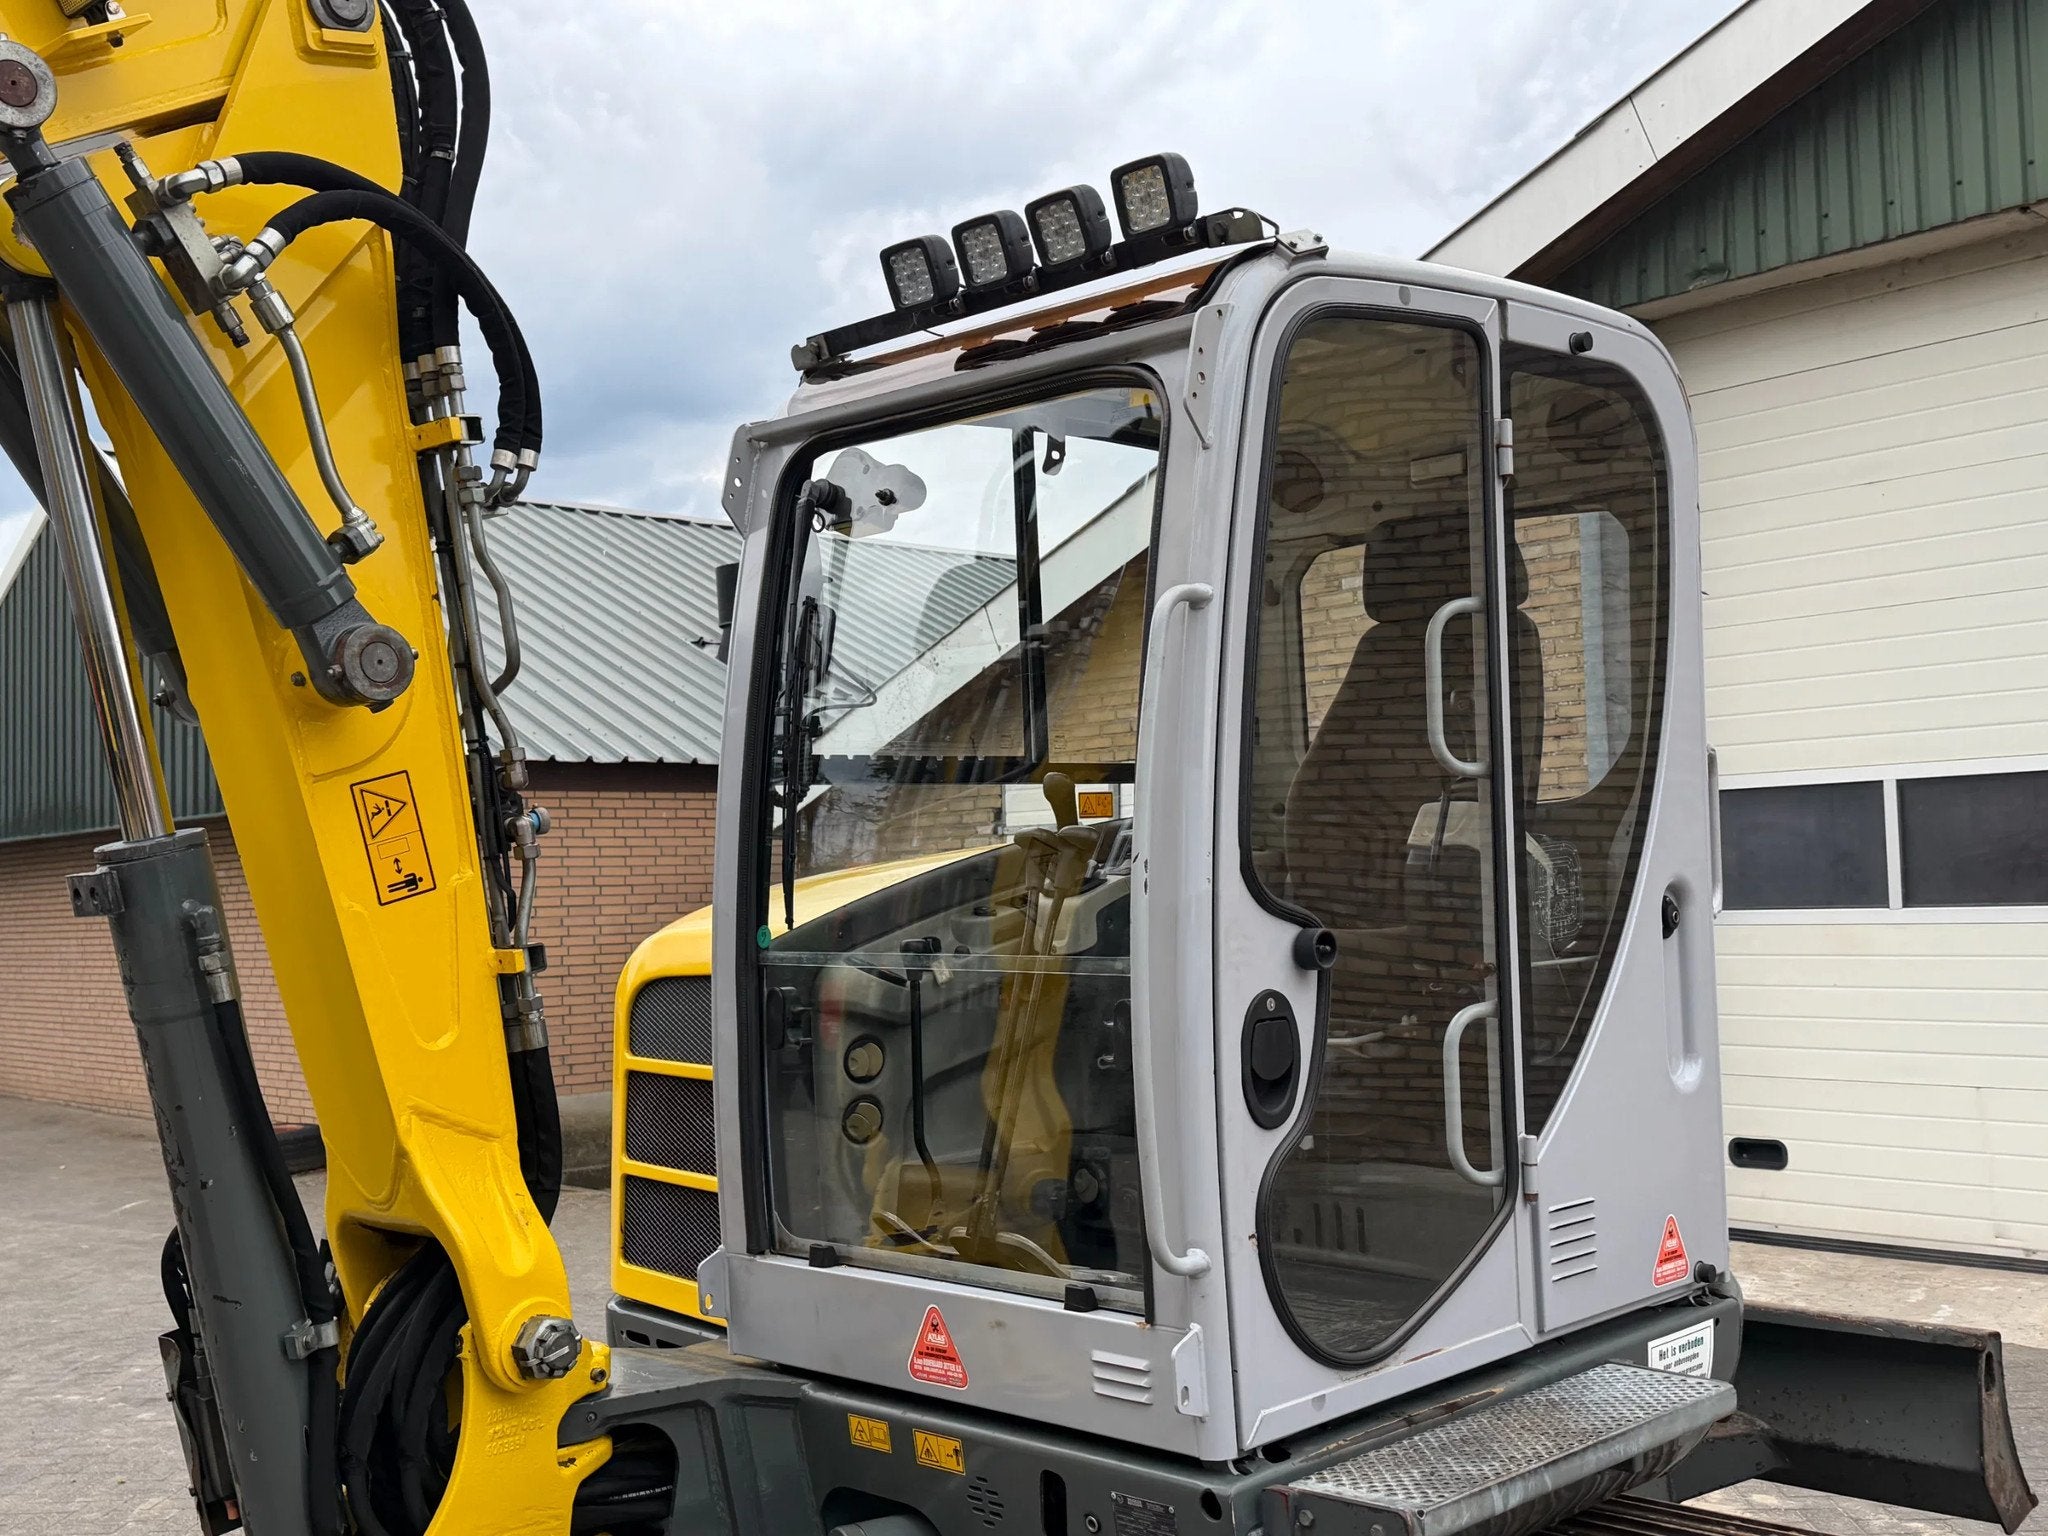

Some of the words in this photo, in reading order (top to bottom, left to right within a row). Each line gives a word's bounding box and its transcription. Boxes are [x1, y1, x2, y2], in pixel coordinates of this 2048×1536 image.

[1659, 1347, 1669, 1361] Het
[1671, 1345, 1676, 1357] is
[1679, 1336, 1703, 1353] verboden
